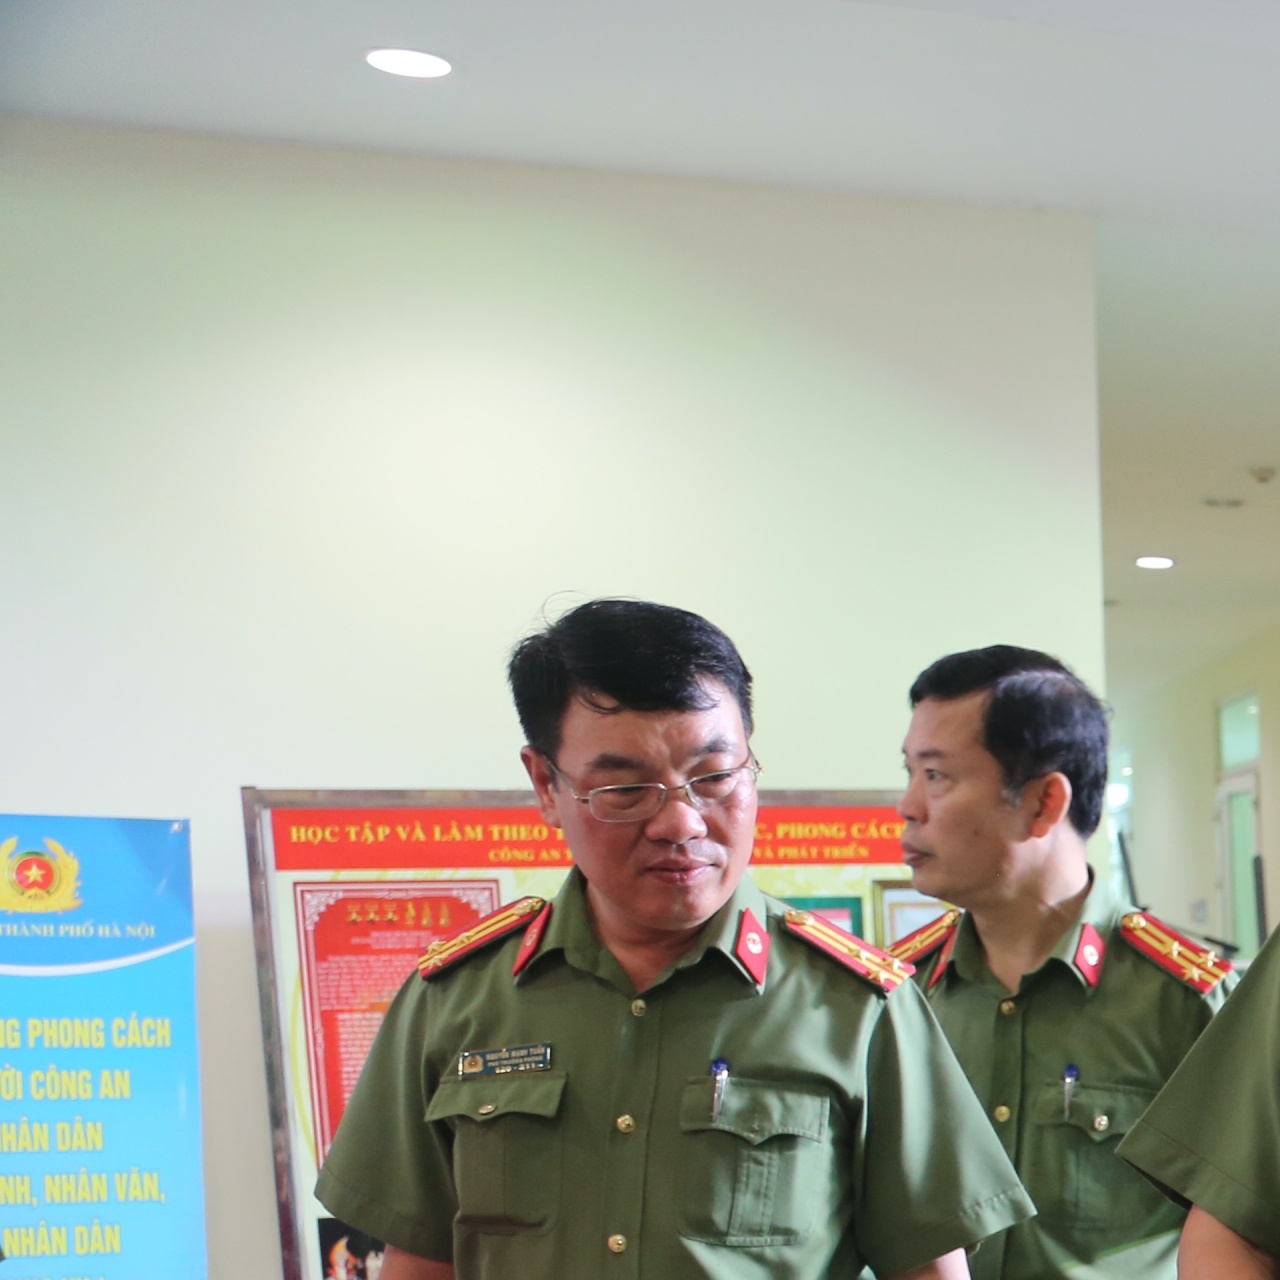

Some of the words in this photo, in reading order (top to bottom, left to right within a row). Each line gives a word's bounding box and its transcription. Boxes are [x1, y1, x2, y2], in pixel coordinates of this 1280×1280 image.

[291, 826, 339, 845] HỌC
[346, 822, 391, 844] TẬP
[396, 821, 426, 842] VÀ
[434, 822, 483, 841] LÀM
[489, 824, 548, 841] THEO
[776, 822, 846, 839] PHONG
[489, 847, 534, 861] CÔNG
[541, 849, 561, 860] AN
[59, 920, 94, 937] PHỐ
[100, 921, 121, 937] HÀ
[126, 922, 155, 940] NỘI
[27, 1017, 105, 1048] PHONG
[112, 1011, 171, 1048] CÁCH
[0, 1063, 23, 1100] ỜI
[31, 1063, 93, 1100] CÔNG
[99, 1069, 131, 1100] AN
[0, 1116, 49, 1152] HÂN
[56, 1115, 103, 1151] DÂN
[45, 1167, 108, 1203] NHÂN
[114, 1166, 166, 1204] VĂN,
[3, 1220, 67, 1257] NHÂN
[74, 1218, 121, 1255] DÂN
